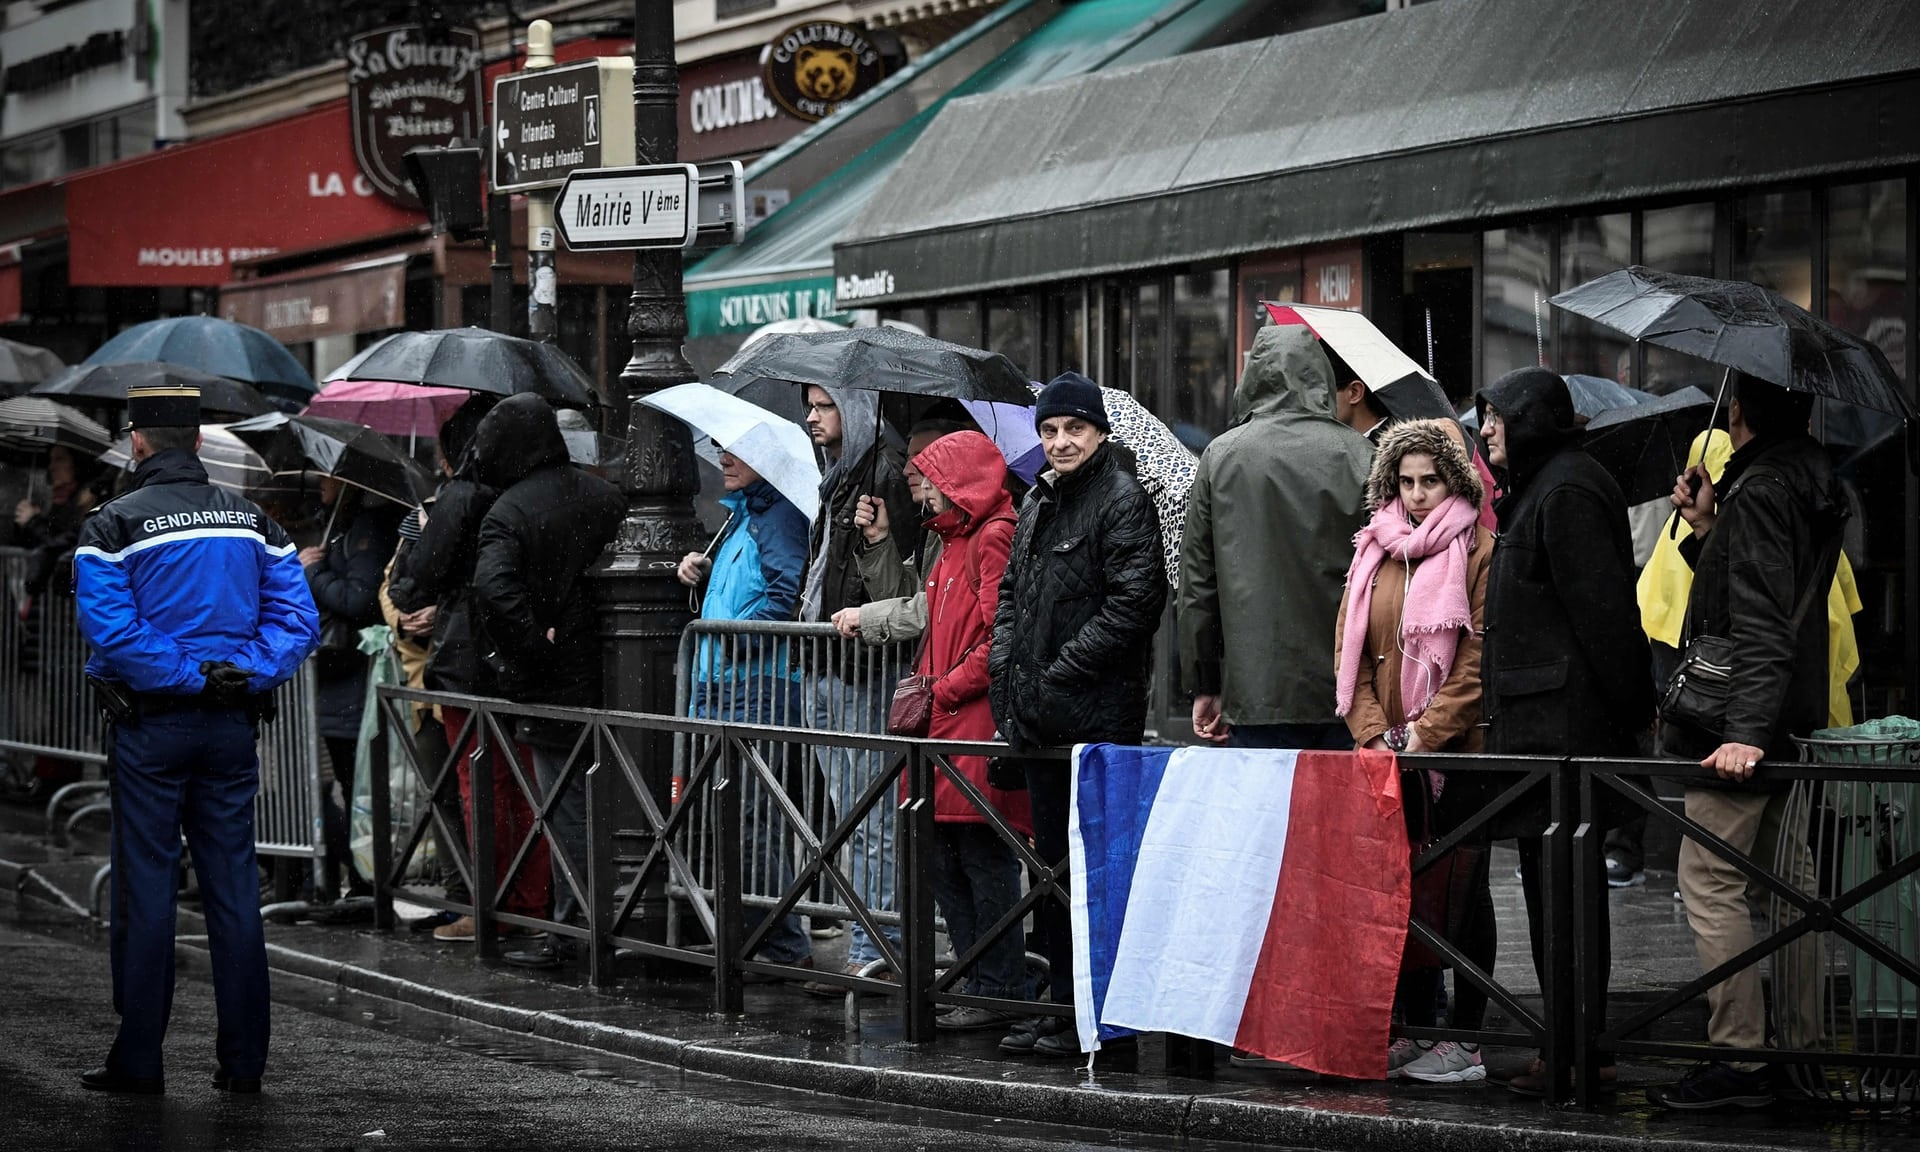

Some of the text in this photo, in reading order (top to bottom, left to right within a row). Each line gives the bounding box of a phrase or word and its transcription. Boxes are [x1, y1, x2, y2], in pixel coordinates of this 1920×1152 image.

[773, 25, 878, 66] COLUMBUS
[521, 82, 578, 111] Centre Culturel
[521, 118, 555, 143] Irlandais
[530, 157, 541, 169] rue
[542, 152, 554, 168] des
[555, 146, 584, 167] Irlandais
[308, 172, 346, 197] LA
[576, 192, 632, 227] Mairie
[138, 248, 224, 266] MOULES
[836, 270, 895, 300] McDonald's
[1320, 264, 1351, 302] MENU
[143, 510, 258, 533] GENDARMERIE
